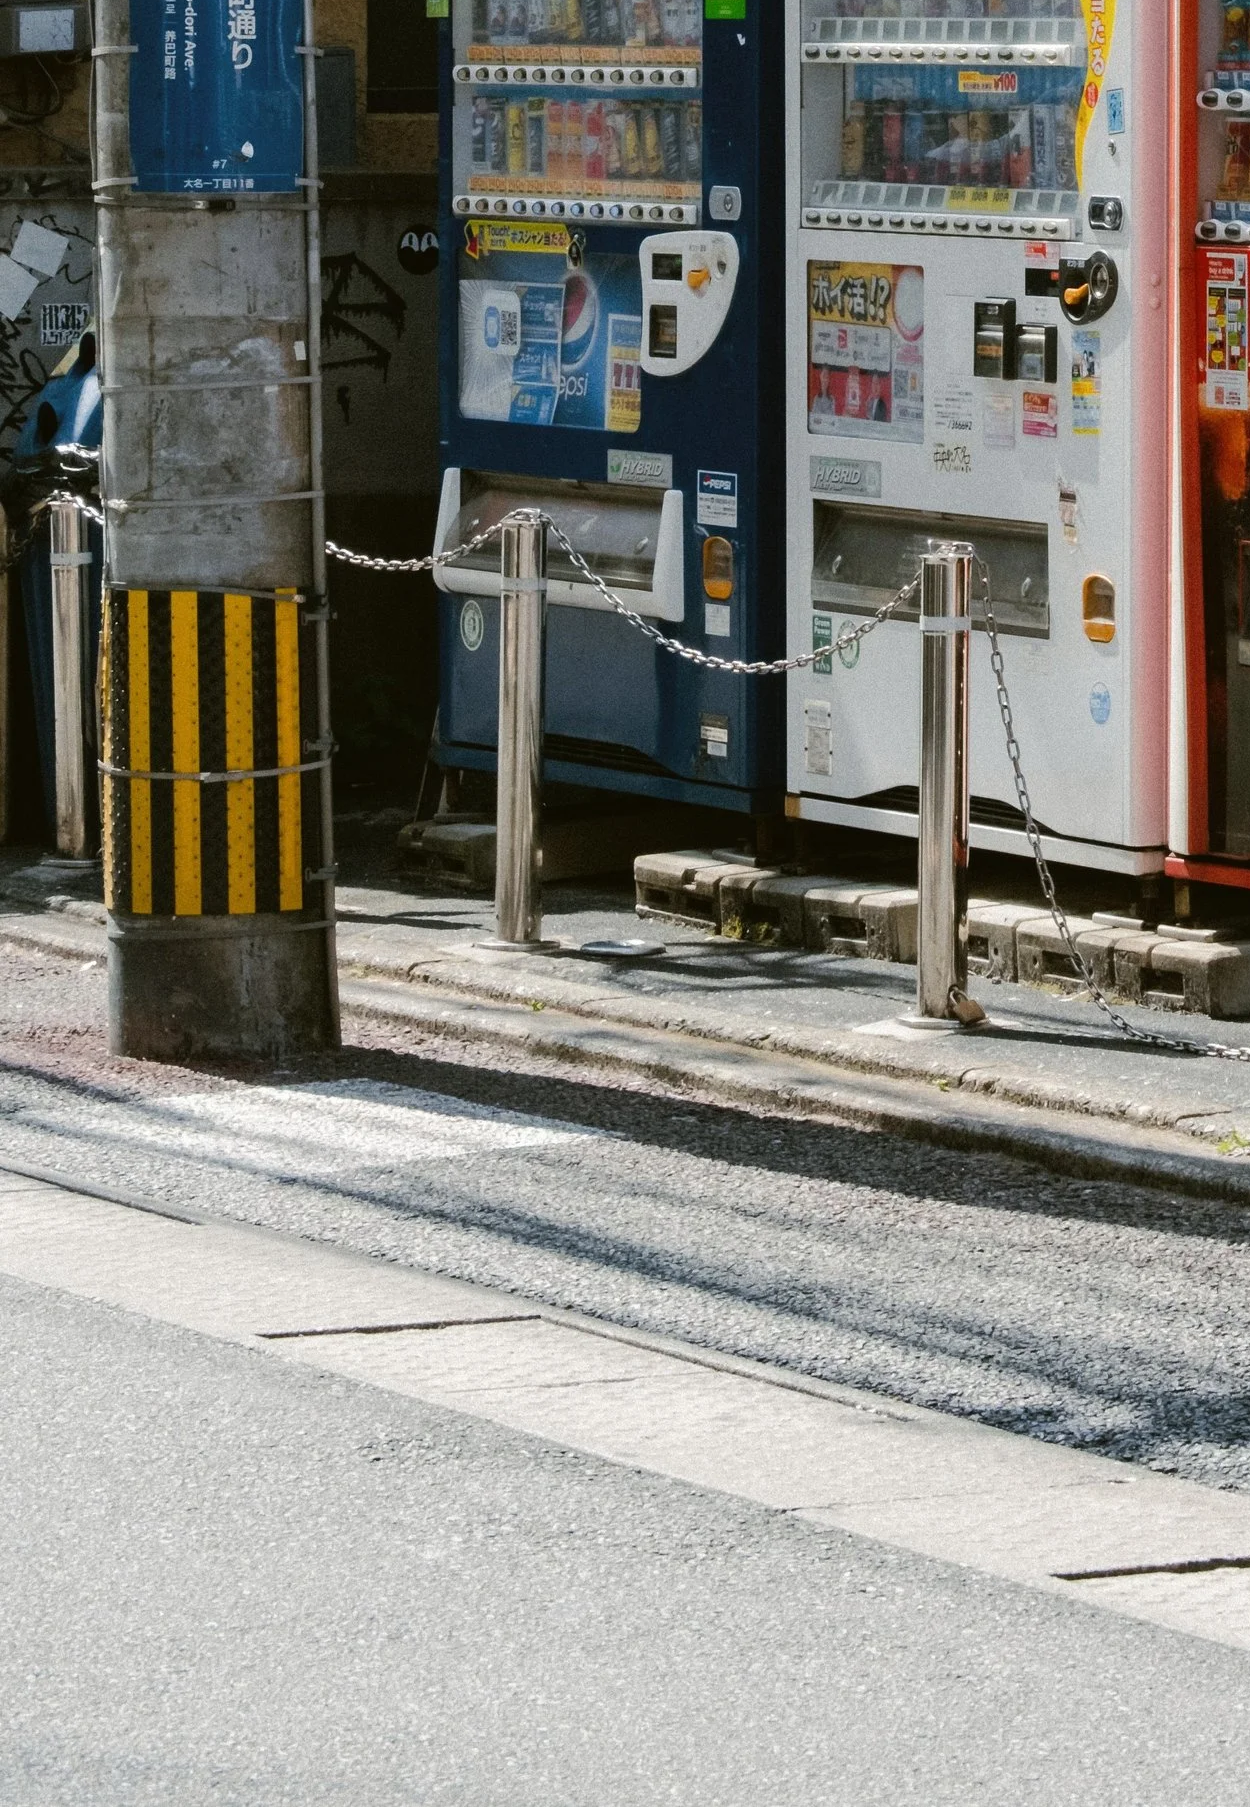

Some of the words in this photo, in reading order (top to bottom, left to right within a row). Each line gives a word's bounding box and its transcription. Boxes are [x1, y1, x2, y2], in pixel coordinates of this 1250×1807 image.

[184, 39, 198, 71] Ave.
[212, 159, 228, 170] #7
[183, 178, 255, 189] 大名一丁目11番
[557, 372, 590, 402] epsi
[619, 458, 664, 480] HYBRID
[813, 466, 862, 486] HYBRID
[709, 478, 732, 491] PEPSI
